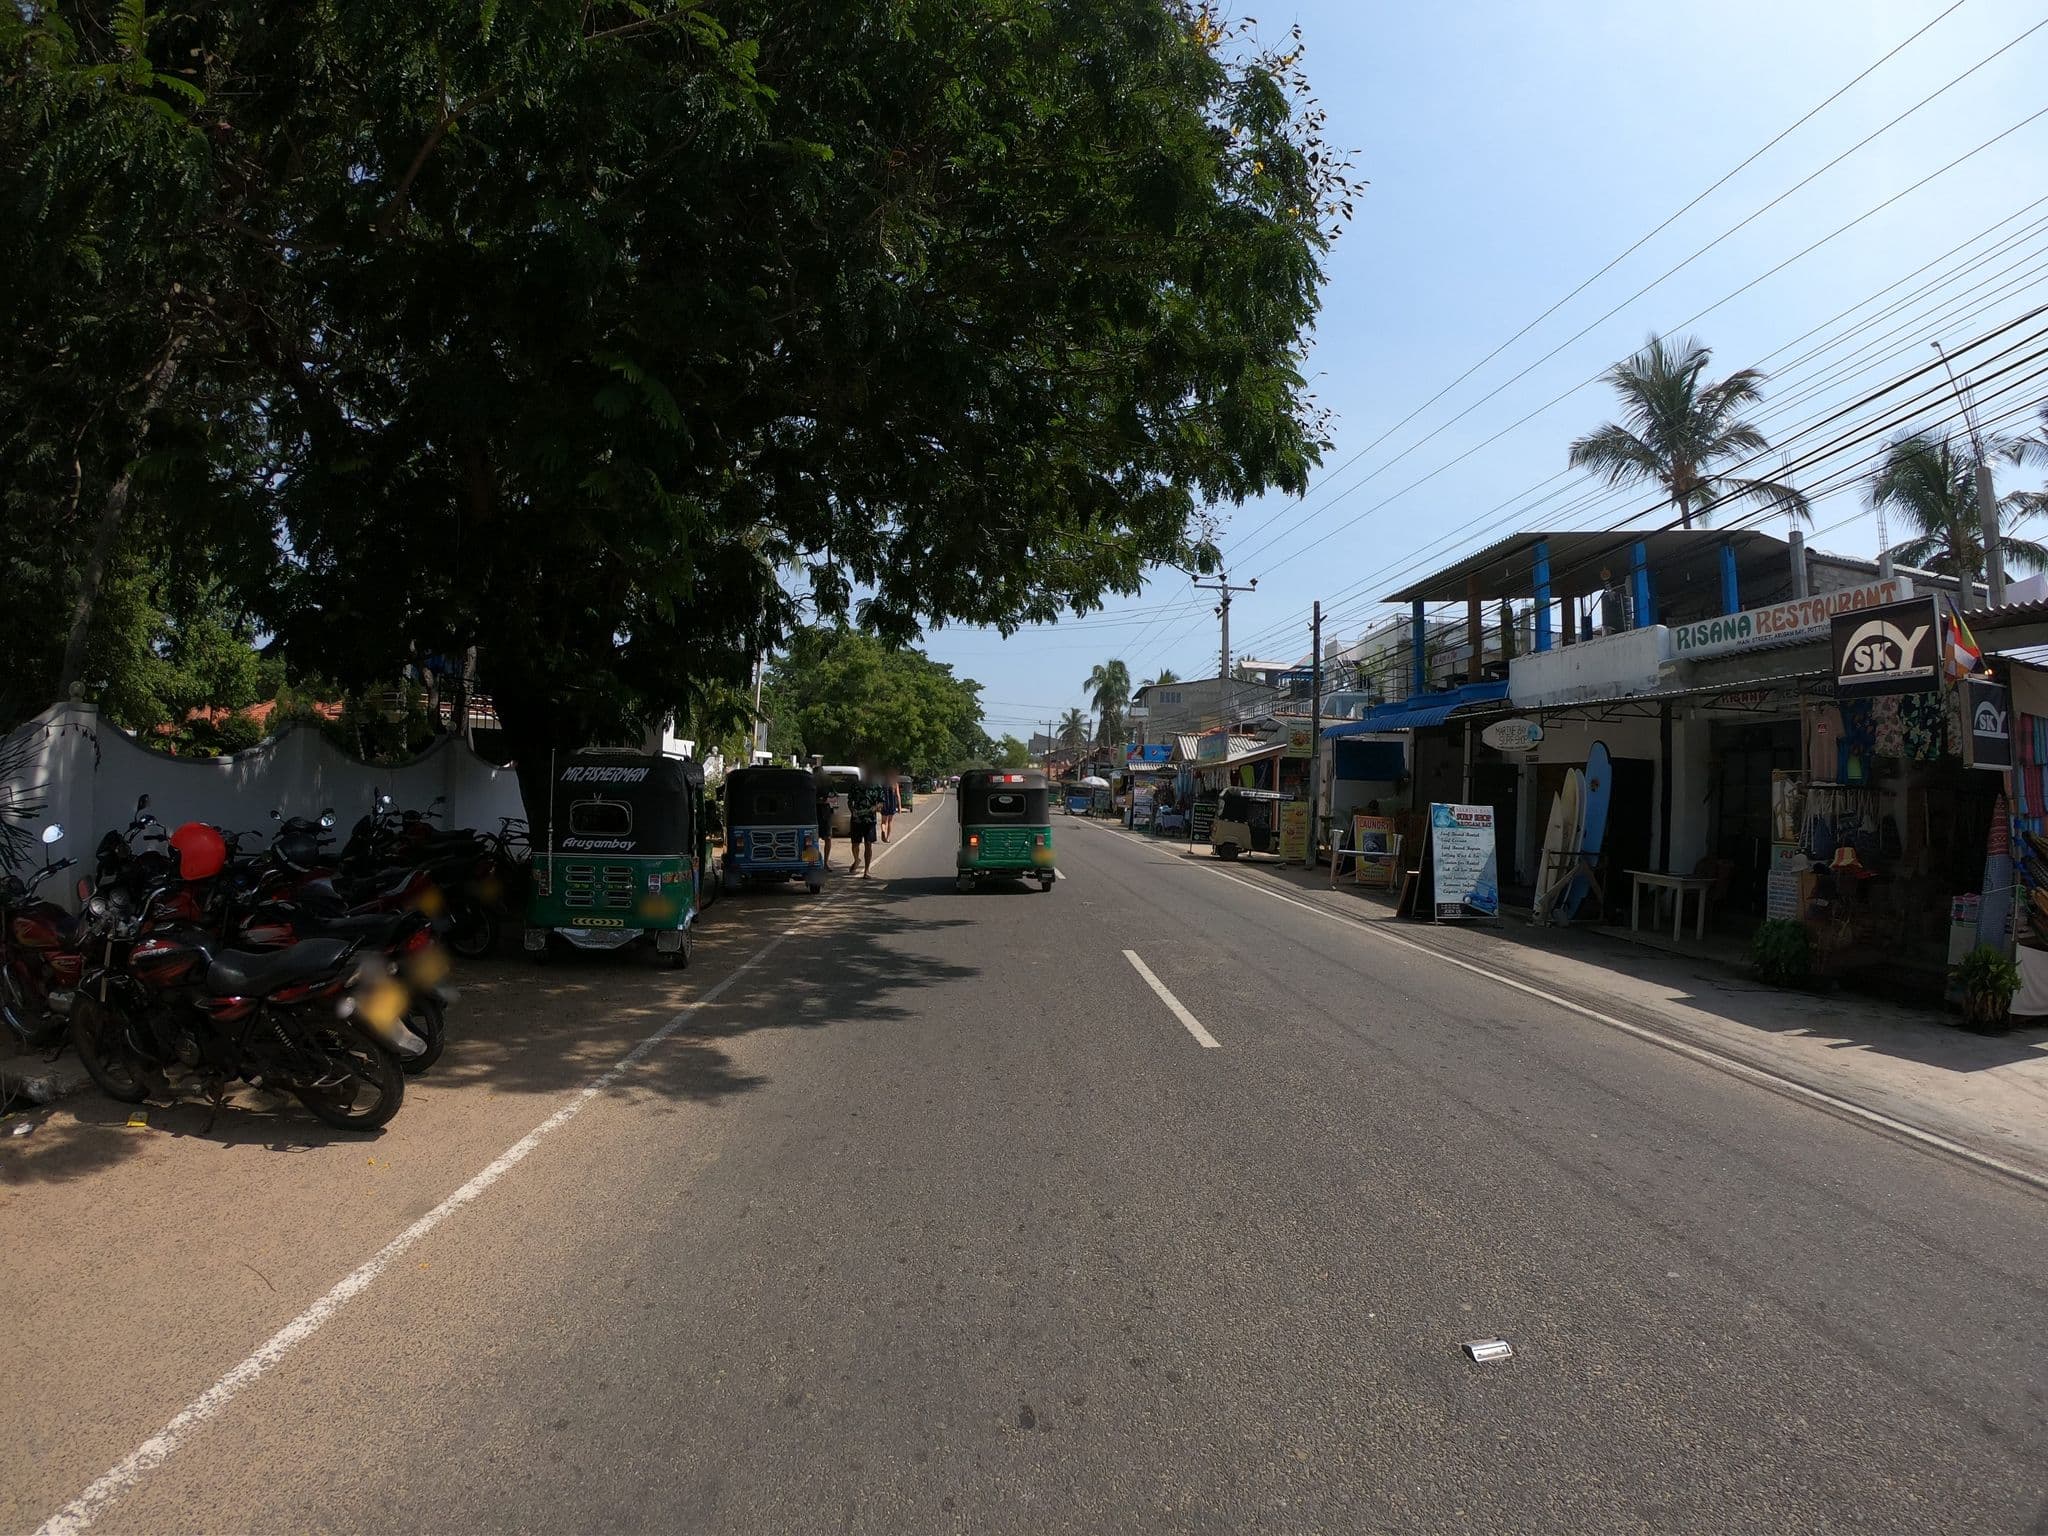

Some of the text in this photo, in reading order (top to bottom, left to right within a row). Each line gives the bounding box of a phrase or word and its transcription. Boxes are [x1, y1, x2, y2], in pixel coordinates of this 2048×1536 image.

[1676, 581, 1897, 651] RISANA RESTAURANT
[1840, 619, 1931, 673] SKY
[1973, 700, 2008, 734] SKY
[562, 837, 637, 851] Arugambay
